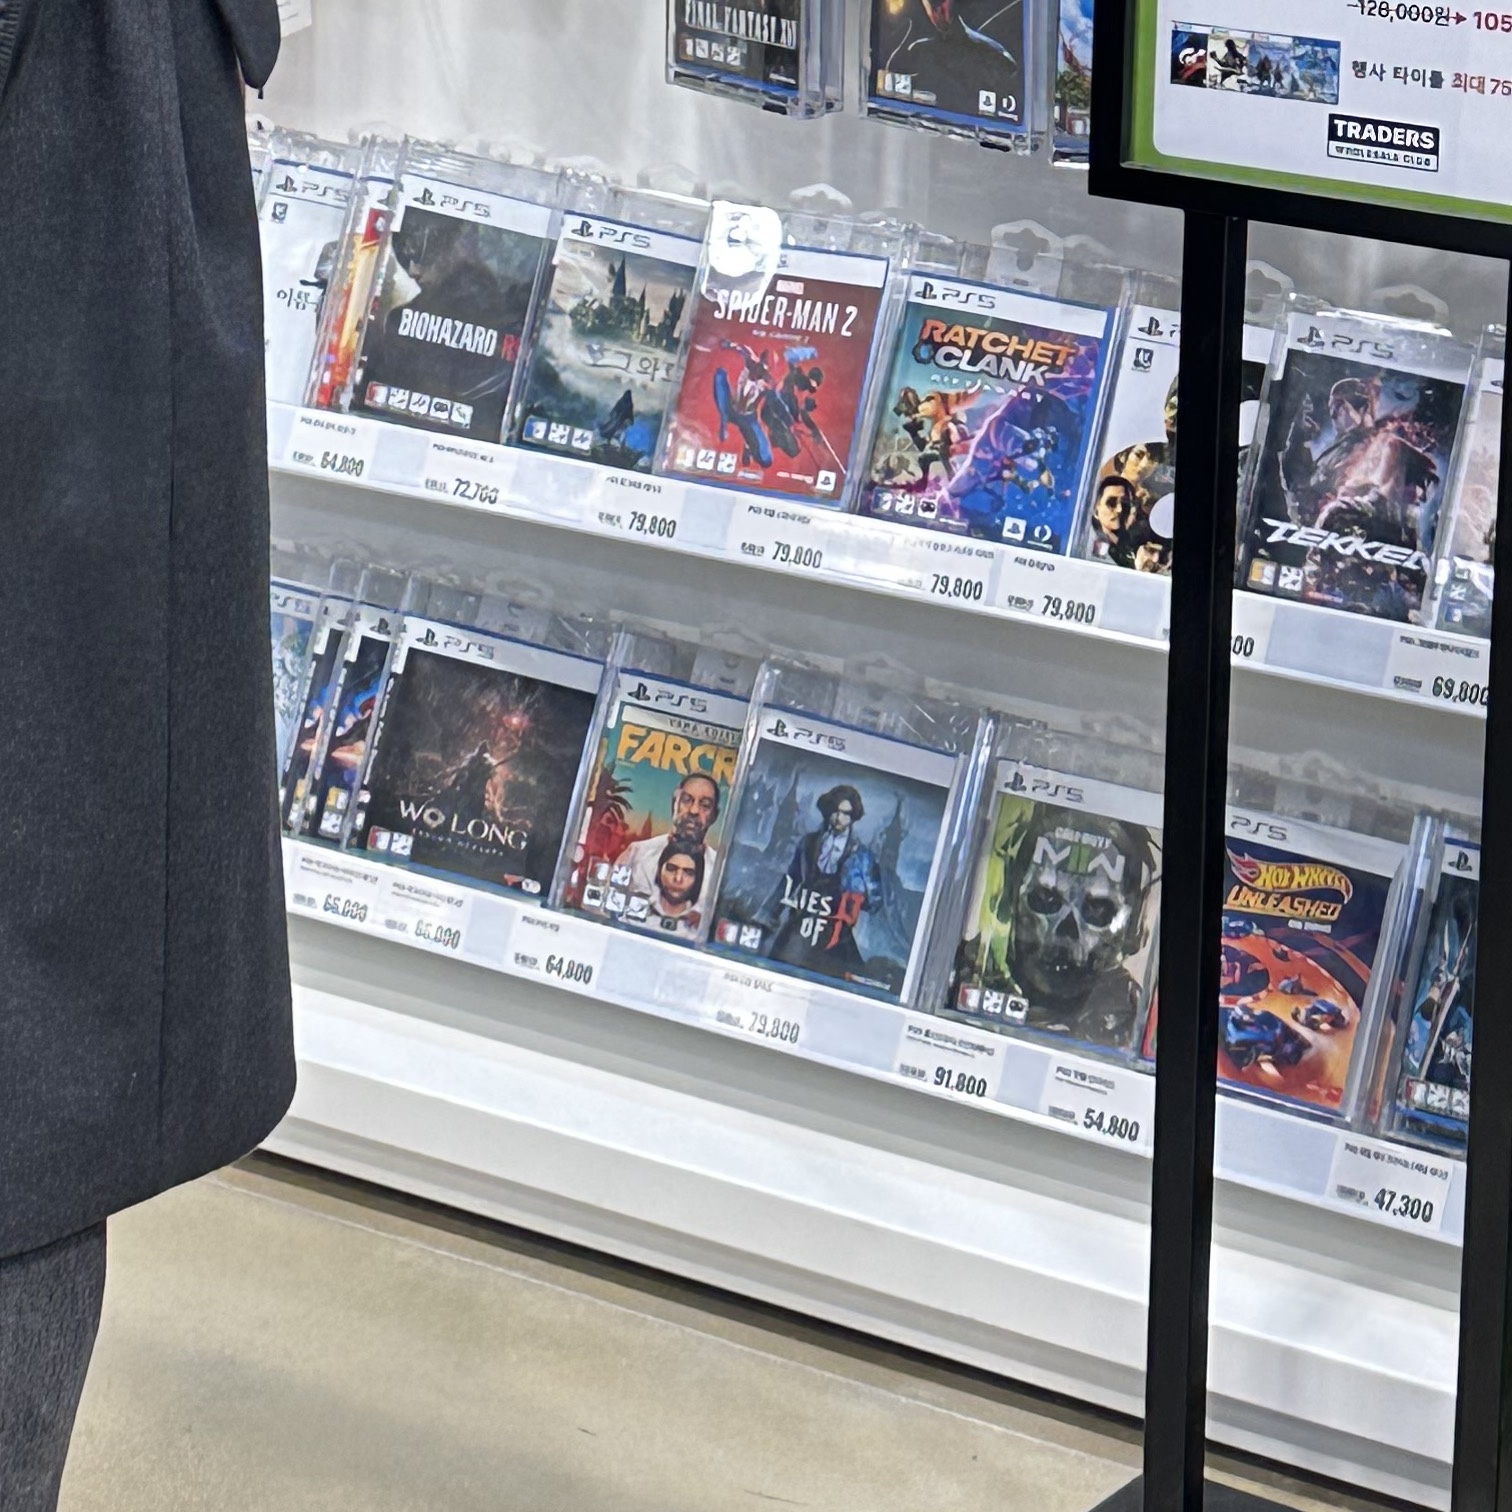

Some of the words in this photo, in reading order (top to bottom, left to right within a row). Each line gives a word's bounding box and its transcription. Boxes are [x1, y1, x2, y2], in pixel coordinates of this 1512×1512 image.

[1472, 10, 1512, 33] 105
[1351, 60, 1386, 82] 행사
[1392, 66, 1444, 89] 타이틀
[1450, 72, 1486, 95] 최대
[1333, 118, 1436, 150] TRADERS
[439, 193, 492, 218] PS5
[598, 225, 652, 249] PS5
[713, 288, 840, 335] SPIDER-MAN
[840, 305, 859, 337] 2
[941, 287, 997, 310] PS5
[397, 307, 498, 358] BIOHAZARD
[920, 318, 1076, 367] RATCHET
[1332, 333, 1395, 360] PS5
[934, 344, 1050, 388] CLANK
[628, 510, 678, 539] 79,800
[771, 540, 824, 570] 79,800
[930, 573, 984, 601] 79,800
[1041, 594, 1097, 624] 79,800
[443, 635, 496, 660] PS5
[654, 688, 708, 713] PS5
[793, 727, 847, 752] PS5
[616, 722, 739, 790] FARCR
[1031, 778, 1085, 804] PS5
[400, 798, 446, 829] WO
[450, 812, 529, 852] LONG
[1230, 814, 1288, 842] PS5
[1257, 864, 1292, 890] HOT
[781, 874, 833, 916] LIES
[1225, 884, 1341, 920] UNLEASHED
[799, 917, 827, 947] OF
[748, 1011, 801, 1045] 79,800
[934, 1065, 989, 1099] 91,800
[1082, 1107, 1141, 1143] 54,800
[1373, 1187, 1435, 1224] 47,300
